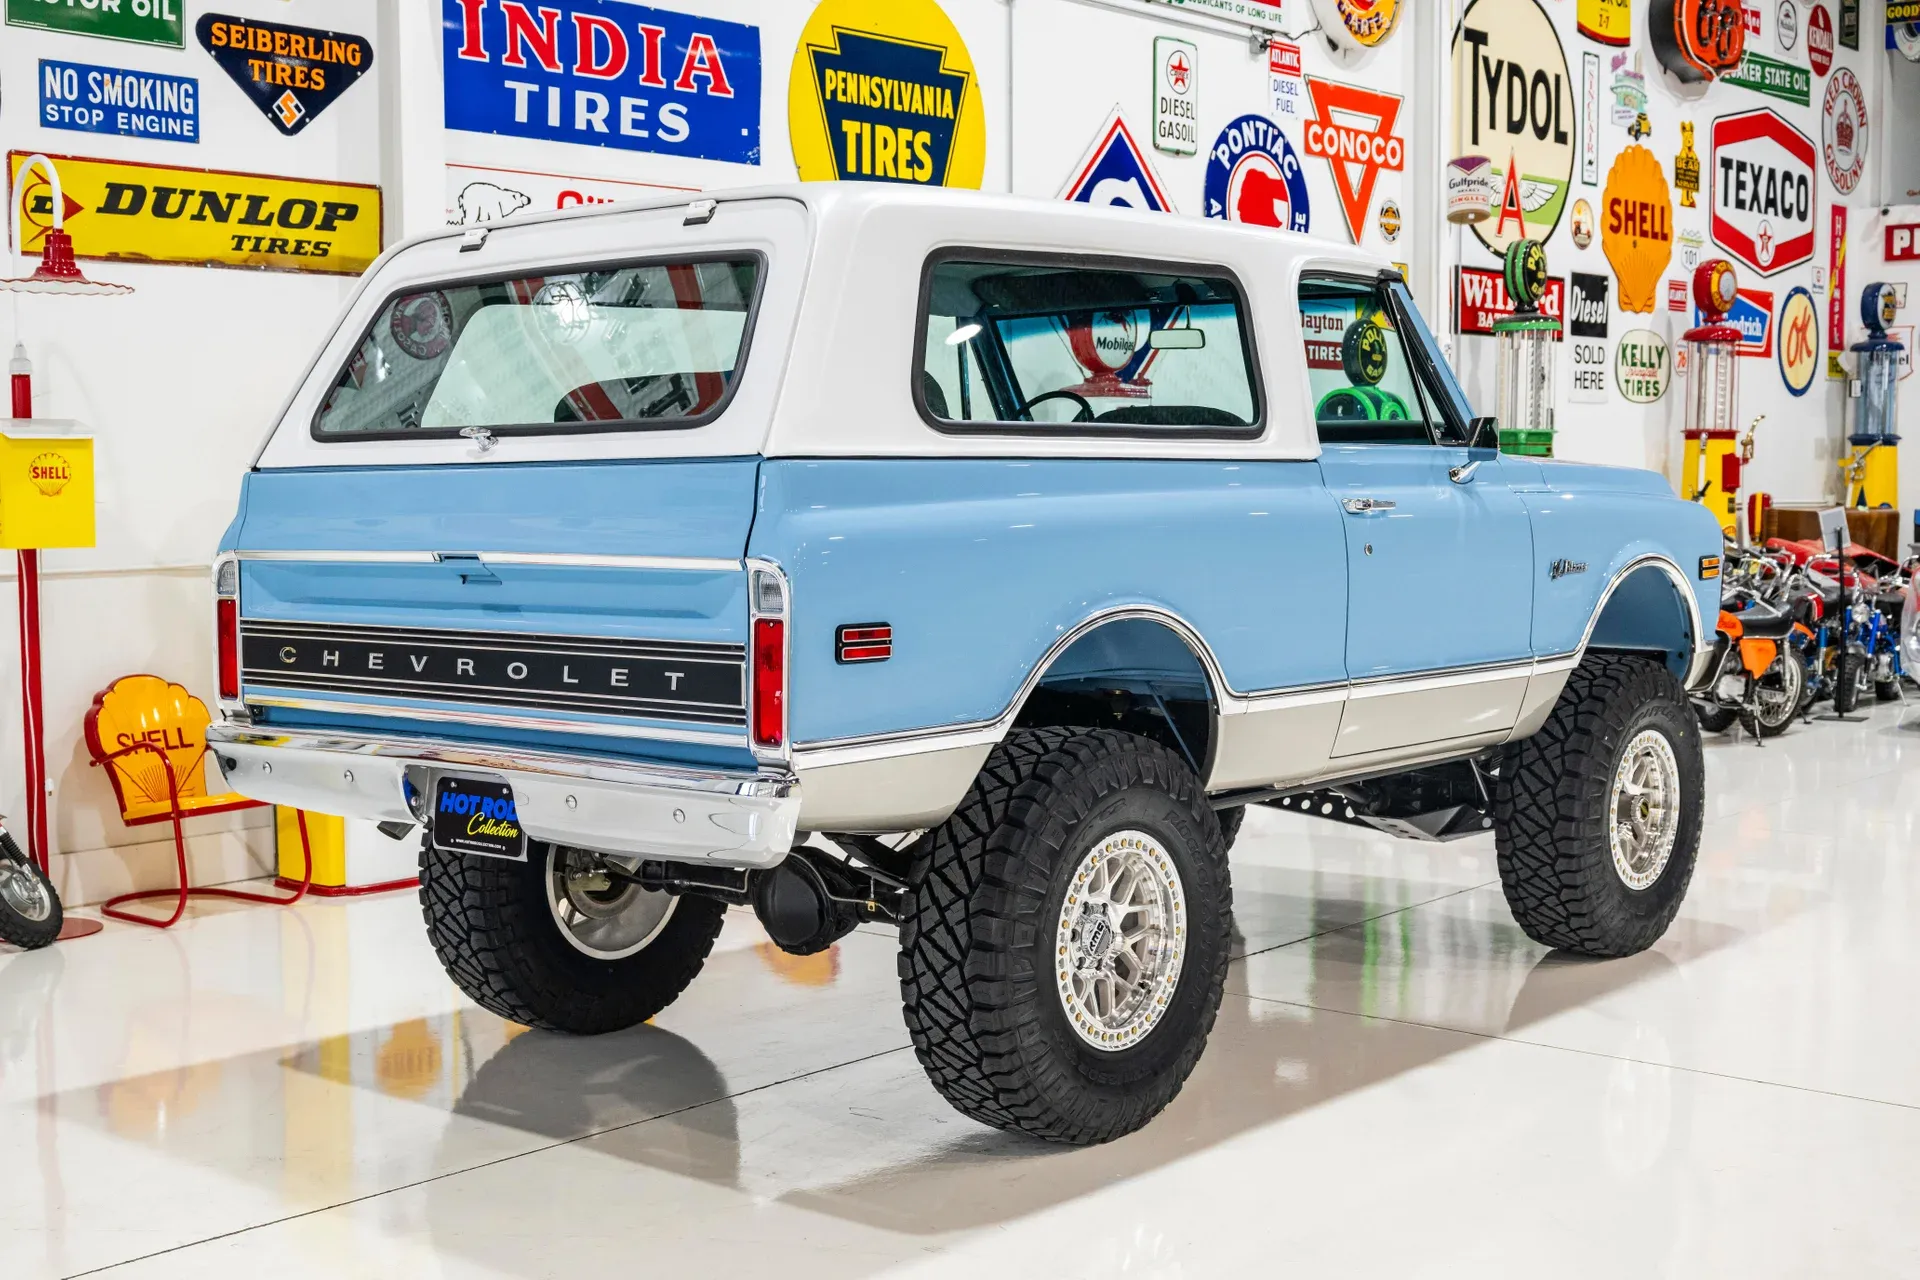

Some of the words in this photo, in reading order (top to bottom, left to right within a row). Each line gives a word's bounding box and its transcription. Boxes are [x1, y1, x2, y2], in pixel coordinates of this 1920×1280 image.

[131, 0, 176, 21] OIL
[1188, 0, 1232, 11] BRICANTS
[1236, 6, 1244, 14] OF
[1248, 8, 1266, 19] LONG
[1269, 11, 1282, 23] LIFE
[1887, 5, 1920, 19] GOOD
[211, 22, 361, 67] SEIBERLING
[459, 0, 734, 98] INDIA
[248, 59, 325, 91] TIRES
[1273, 79, 1298, 96] DIESEL
[1464, 26, 1568, 146] TYDOL
[1765, 67, 1790, 88] STATE
[1793, 72, 1808, 91] OIL
[45, 66, 78, 101] NO
[88, 71, 193, 115] SMOKING
[824, 69, 954, 120] PENNSYLVANIA
[1276, 98, 1295, 113] FUEL
[1825, 76, 1840, 117] RED
[1842, 71, 1866, 128] CROWN
[46, 105, 104, 126] STOP
[117, 111, 194, 136] ENGINE
[504, 80, 690, 143] TIRES
[1160, 97, 1195, 120] DIESEL
[1587, 70, 1595, 152] SINCLAIR
[1159, 119, 1195, 143] GASOIL
[1308, 124, 1401, 166] CONOCO
[842, 119, 933, 182] TIRES
[1213, 121, 1298, 179] PONTIAC
[1826, 143, 1864, 190] GASOLINE
[1449, 177, 1489, 190] Gulfpride
[1720, 156, 1809, 222] TEXACO
[96, 182, 359, 231] DUNLOP
[1609, 198, 1668, 241] SHELL
[231, 234, 331, 257] TIRES
[1684, 249, 1698, 265] 101
[1462, 273, 1560, 315] Wilrd
[1571, 285, 1608, 324] Diesel
[1096, 336, 1134, 354] Mobilgas
[1787, 305, 1812, 368] OK
[1308, 345, 1343, 361] TIRES
[1575, 344, 1605, 364] SOLD
[1621, 343, 1665, 369] KELLY
[1575, 370, 1604, 390] HERE
[1625, 379, 1660, 397] TIRES
[32, 466, 68, 479] SHELL
[280, 646, 685, 692] CHEVROLET
[117, 727, 194, 756] SHELL
[440, 792, 481, 816] HOT
[467, 812, 519, 838] Collection
